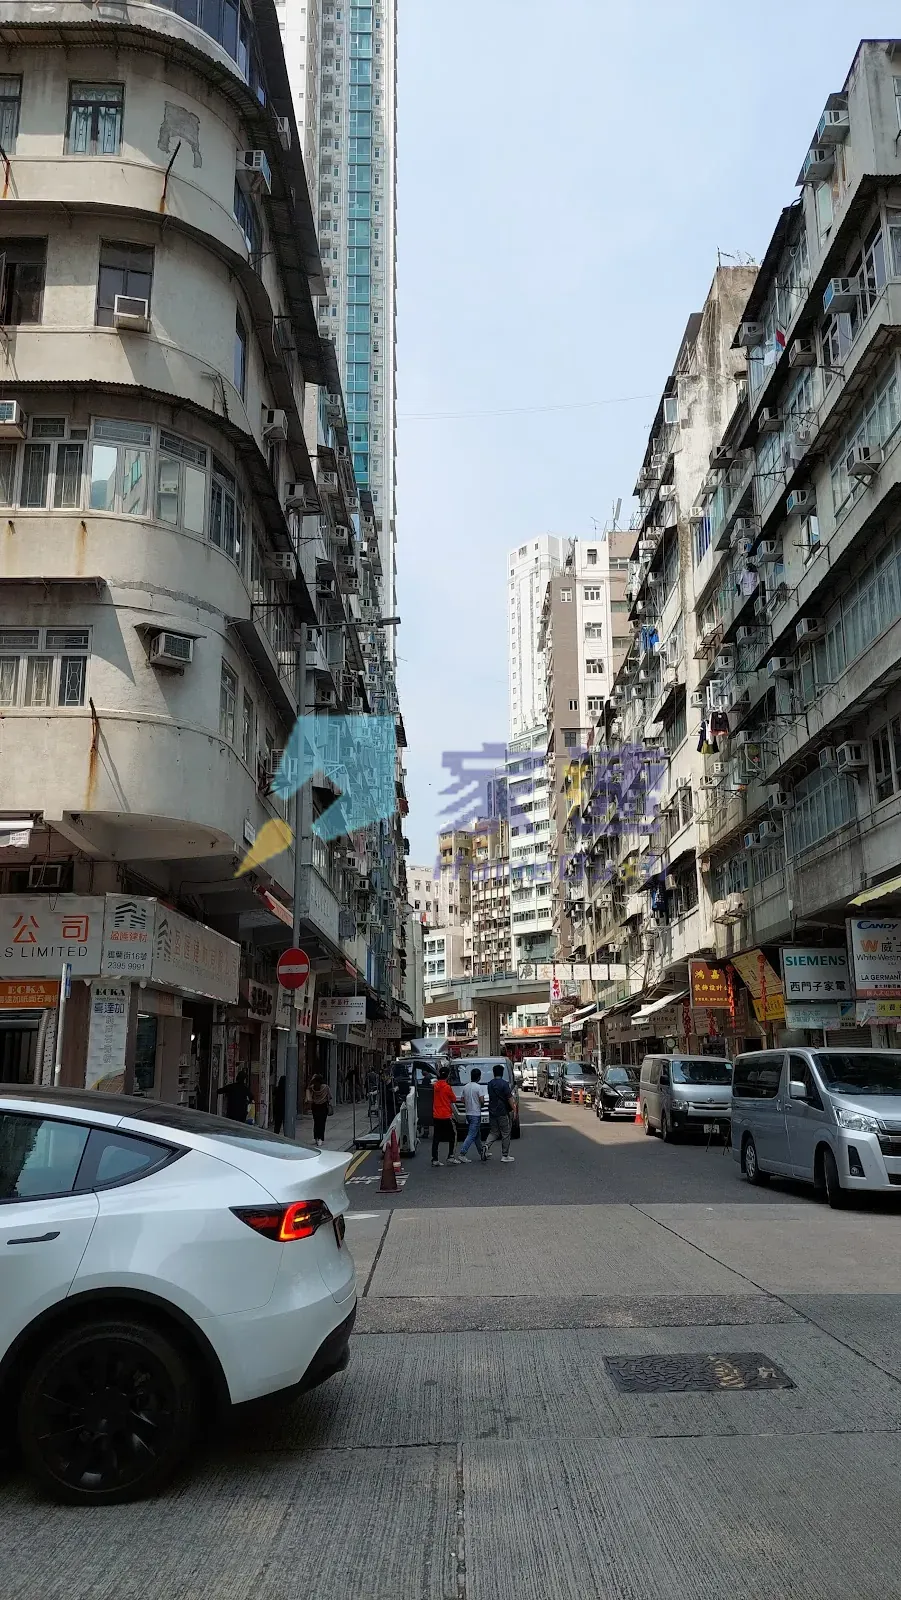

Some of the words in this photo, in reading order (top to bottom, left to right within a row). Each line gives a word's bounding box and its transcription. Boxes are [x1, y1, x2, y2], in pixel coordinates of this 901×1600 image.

[857, 921, 898, 930] CANDY
[0, 947, 14, 958] S
[21, 946, 88, 957] LIMITED
[785, 955, 846, 966] SIEMENS
[8, 985, 46, 994] ECKA
[789, 980, 847, 992] 西門子家電
[95, 988, 126, 996] ECKA
